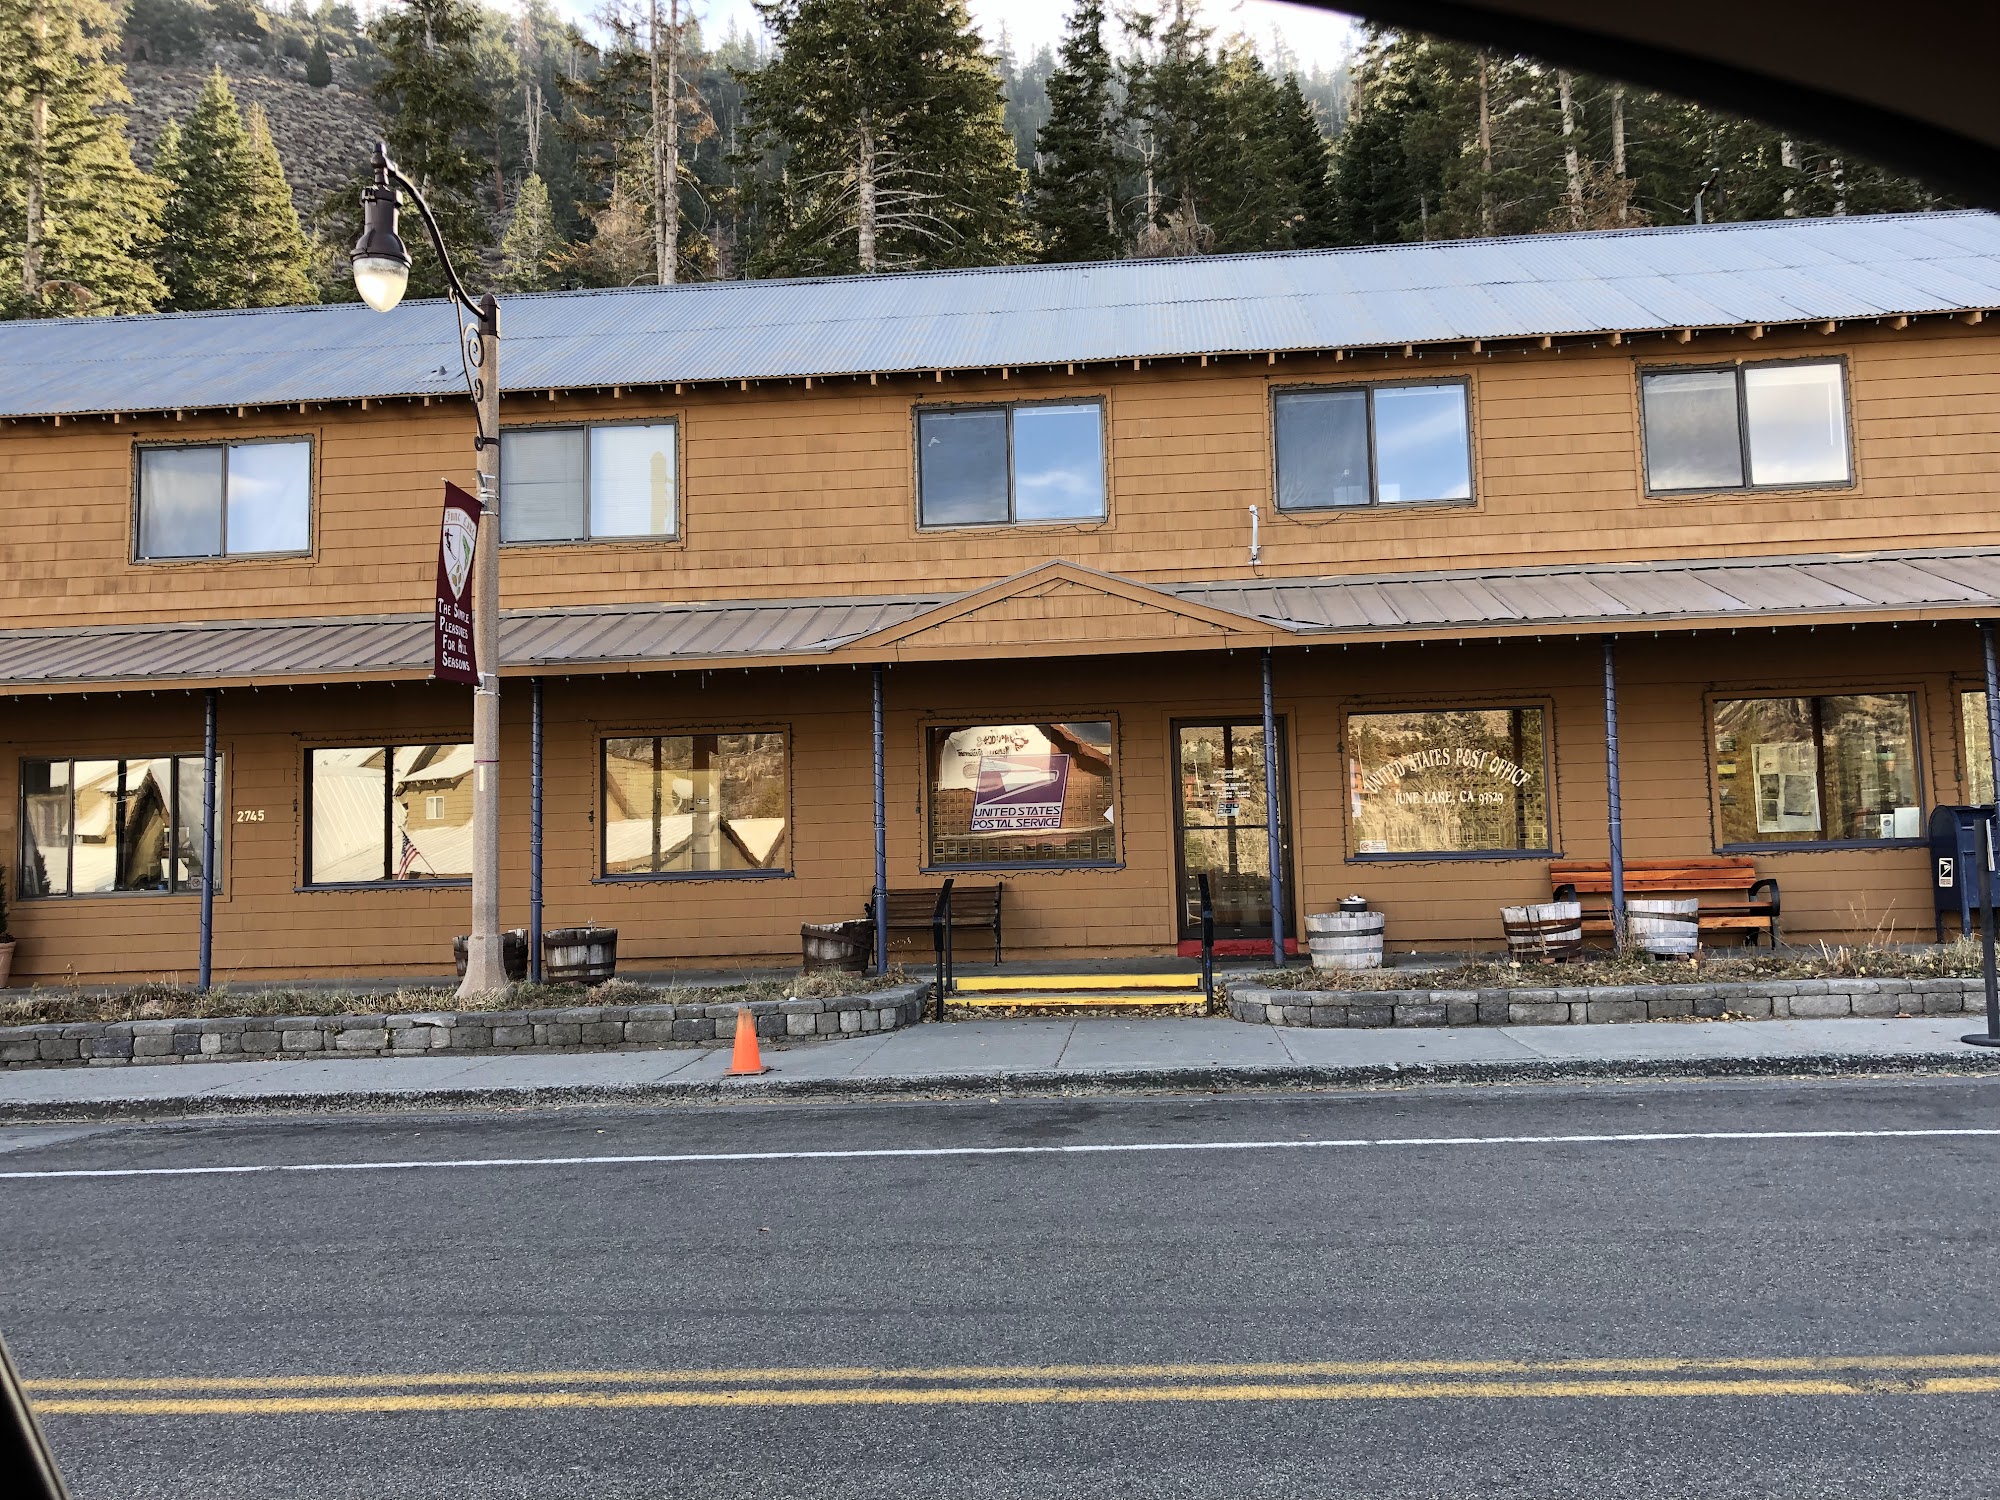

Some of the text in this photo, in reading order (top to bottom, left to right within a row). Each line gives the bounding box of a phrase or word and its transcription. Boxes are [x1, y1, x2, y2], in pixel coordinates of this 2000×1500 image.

[1365, 760, 1406, 794] UNITED
[1407, 748, 1450, 772] STATES
[1456, 748, 1487, 769] POST
[1395, 790, 1504, 806] JUNE LAKE, CA 93529
[237, 810, 265, 822] 2745
[974, 806, 1061, 817] UNITED STATES
[973, 818, 1060, 829] POSTAL SERVICE
